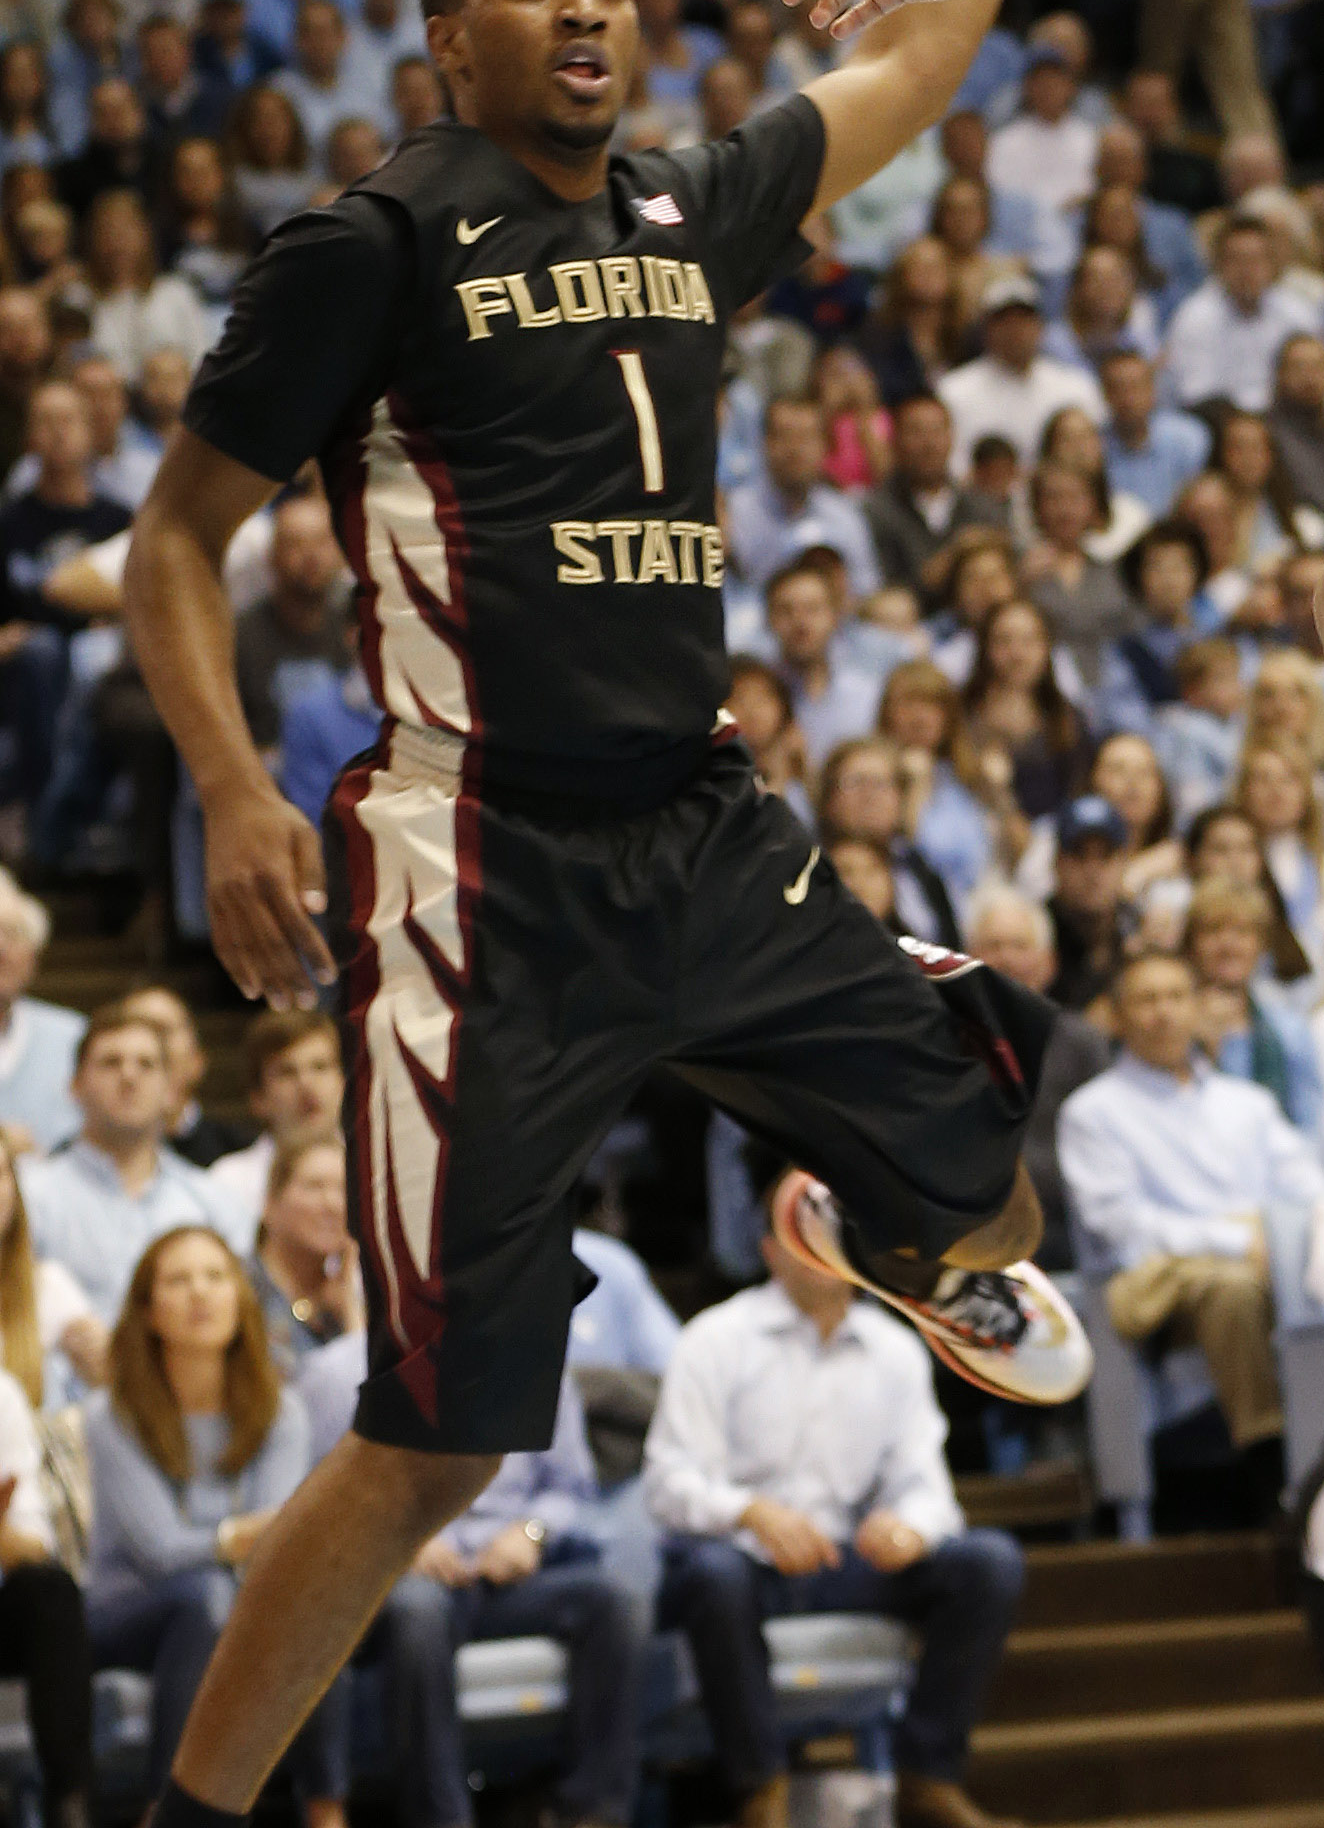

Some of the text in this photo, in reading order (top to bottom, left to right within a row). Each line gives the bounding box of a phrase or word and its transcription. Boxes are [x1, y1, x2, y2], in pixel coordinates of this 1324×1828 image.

[454, 255, 716, 341] FLORIDA
[609, 349, 664, 494] 1
[550, 519, 725, 588] STATE
